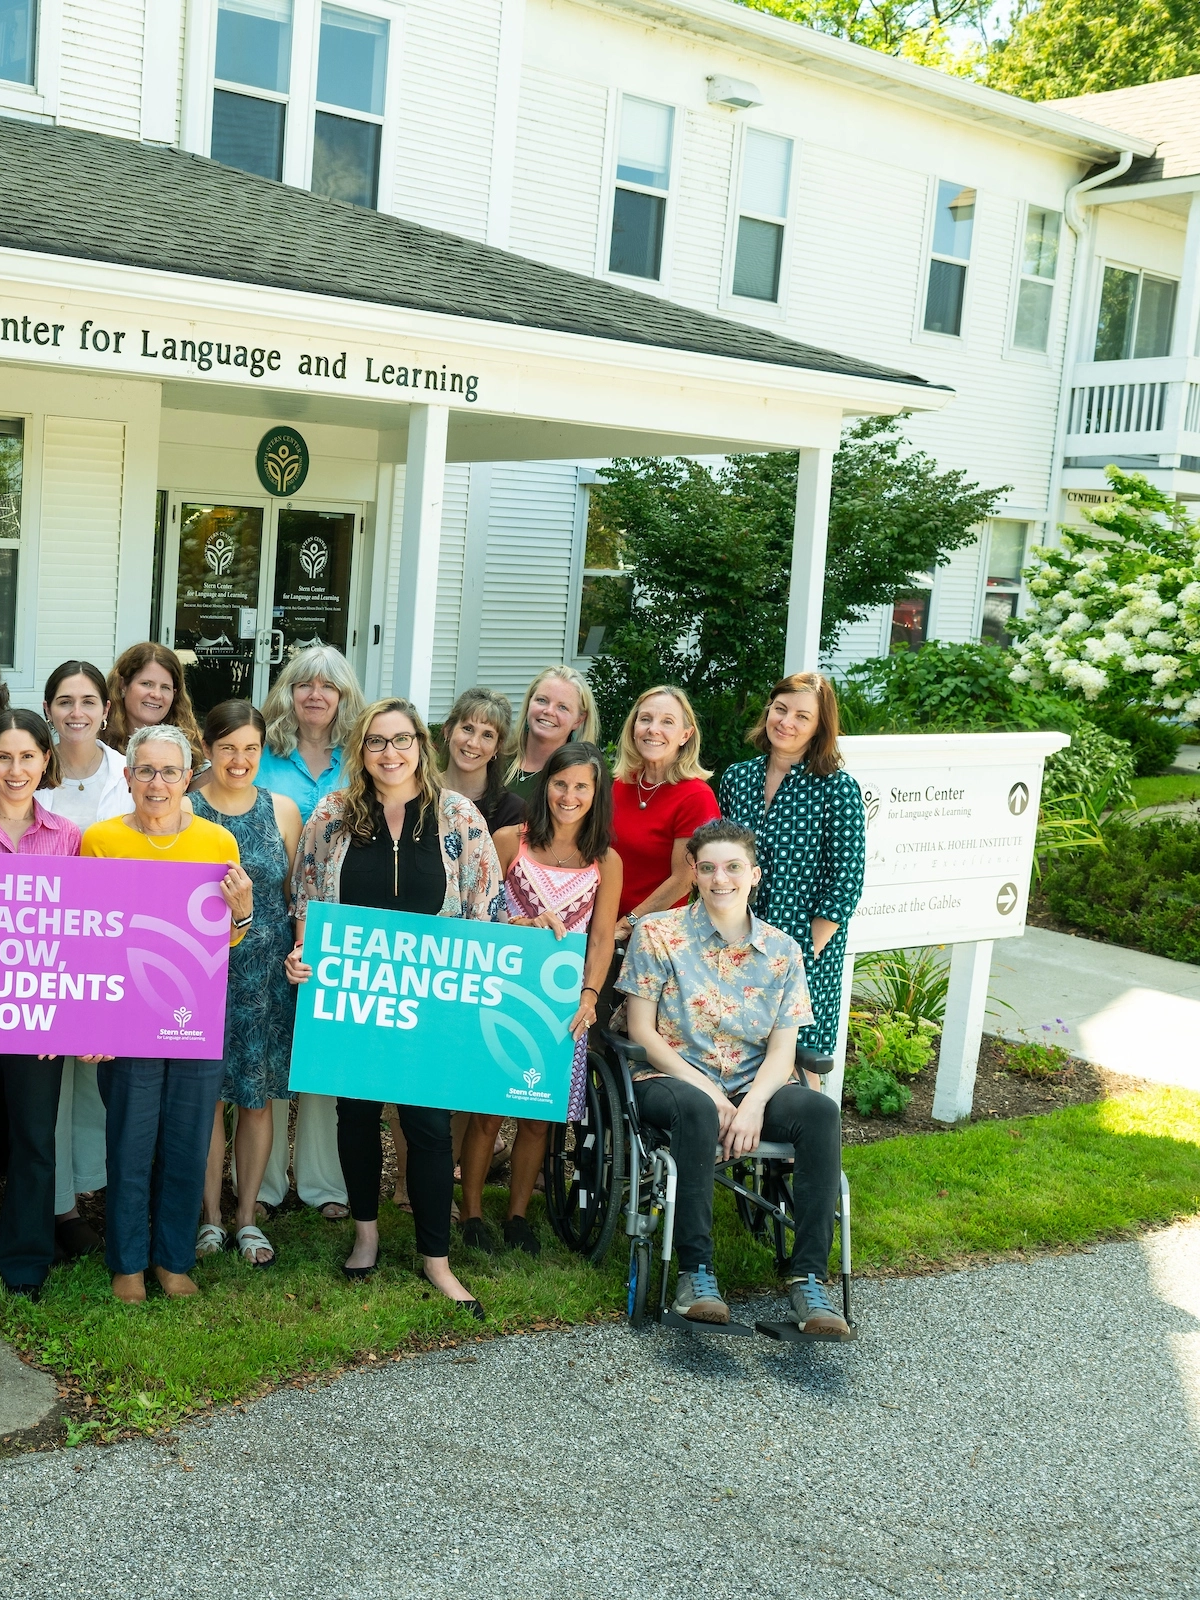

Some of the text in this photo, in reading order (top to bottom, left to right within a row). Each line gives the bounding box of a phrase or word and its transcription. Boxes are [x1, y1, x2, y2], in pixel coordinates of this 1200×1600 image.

[79, 320, 126, 354] for
[141, 329, 282, 378] Language
[298, 352, 347, 380] and
[365, 357, 480, 401] Learning
[266, 434, 302, 454] STERN CENTER
[1067, 492, 1101, 504] CYNTHIA
[890, 786, 965, 803] Stern Center
[888, 809, 898, 819] for
[900, 808, 933, 821] Language
[934, 808, 940, 816] &
[942, 807, 972, 818] Learning
[896, 836, 1022, 853] CYNTHIA K. HOEHL INSTITUTE
[853, 895, 962, 917] ssociates at the Gables
[320, 922, 524, 976] LEARNING
[316, 956, 504, 1006] CHANGES
[313, 988, 420, 1030] LIVES
[528, 1090, 551, 1098] Center
